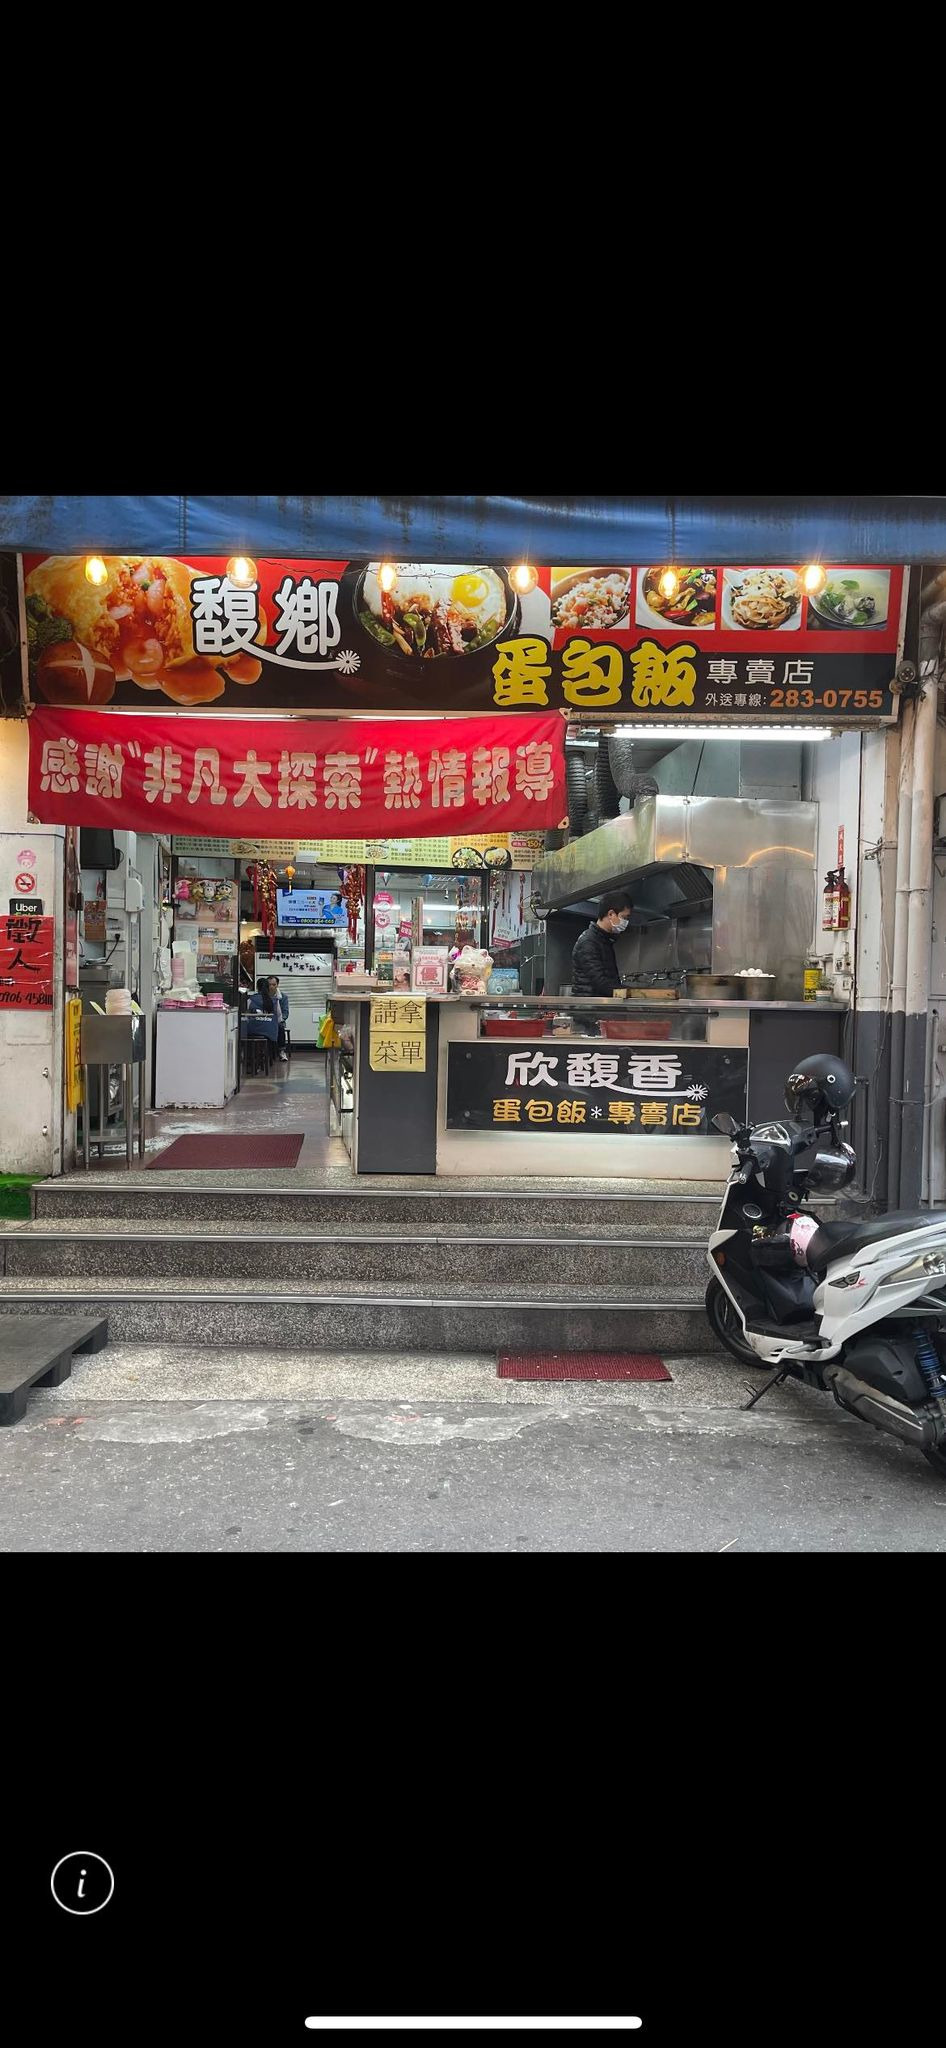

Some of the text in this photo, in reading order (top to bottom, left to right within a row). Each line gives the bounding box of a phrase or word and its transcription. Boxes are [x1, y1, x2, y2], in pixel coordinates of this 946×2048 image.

[193, 578, 341, 656] 馥鄉
[492, 637, 697, 707] 蛋包飯
[706, 659, 814, 685] 專賣店
[769, 689, 883, 708] 283-0755
[15, 903, 37, 912] Uber
[375, 1000, 423, 1024] 請拿
[374, 1040, 423, 1064] 菜單
[505, 1051, 682, 1089] 欣馥香
[493, 1099, 702, 1127] 蛋包飯 專賣店
